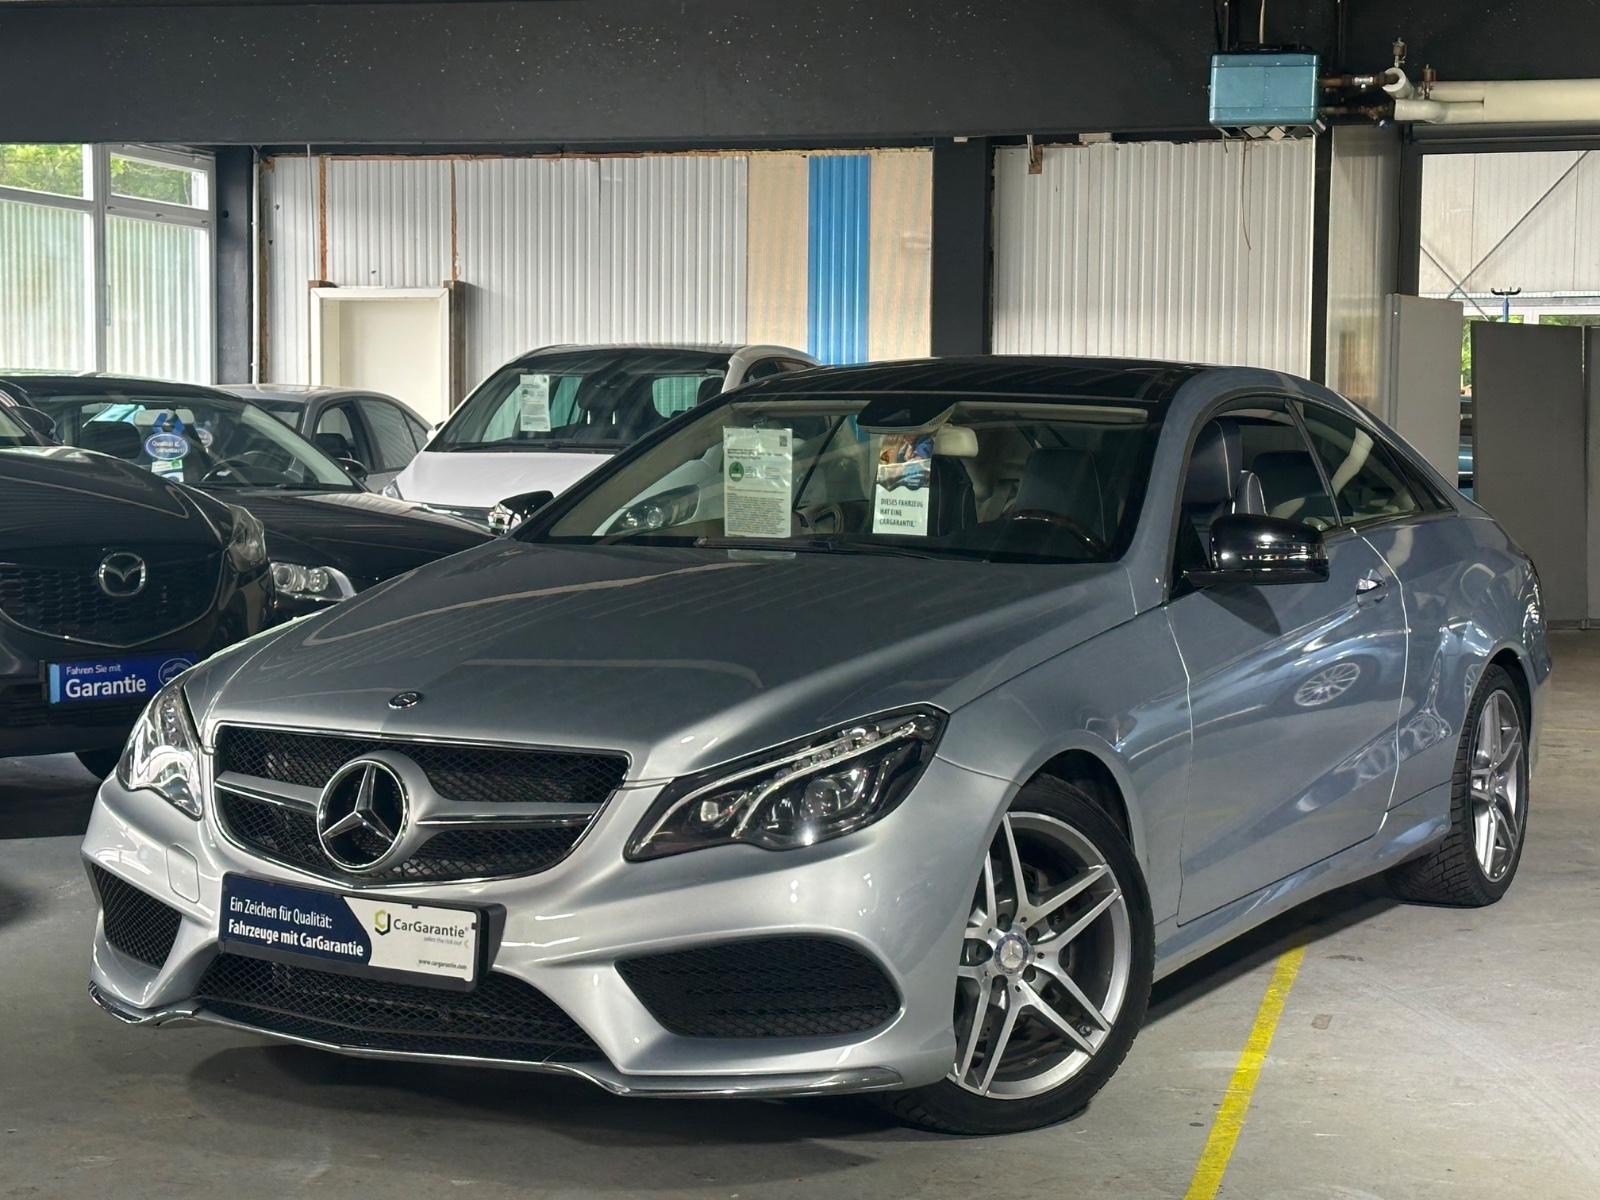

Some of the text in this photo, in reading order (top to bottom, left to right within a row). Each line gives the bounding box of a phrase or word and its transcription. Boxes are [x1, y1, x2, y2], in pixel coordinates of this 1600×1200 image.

[66, 663, 122, 676] Fahren Sie mit
[65, 674, 147, 698] Garantie
[230, 896, 333, 929] Ein Zeichen für Qualität:
[228, 918, 364, 956] Fahrzeuge mit CarGarantie
